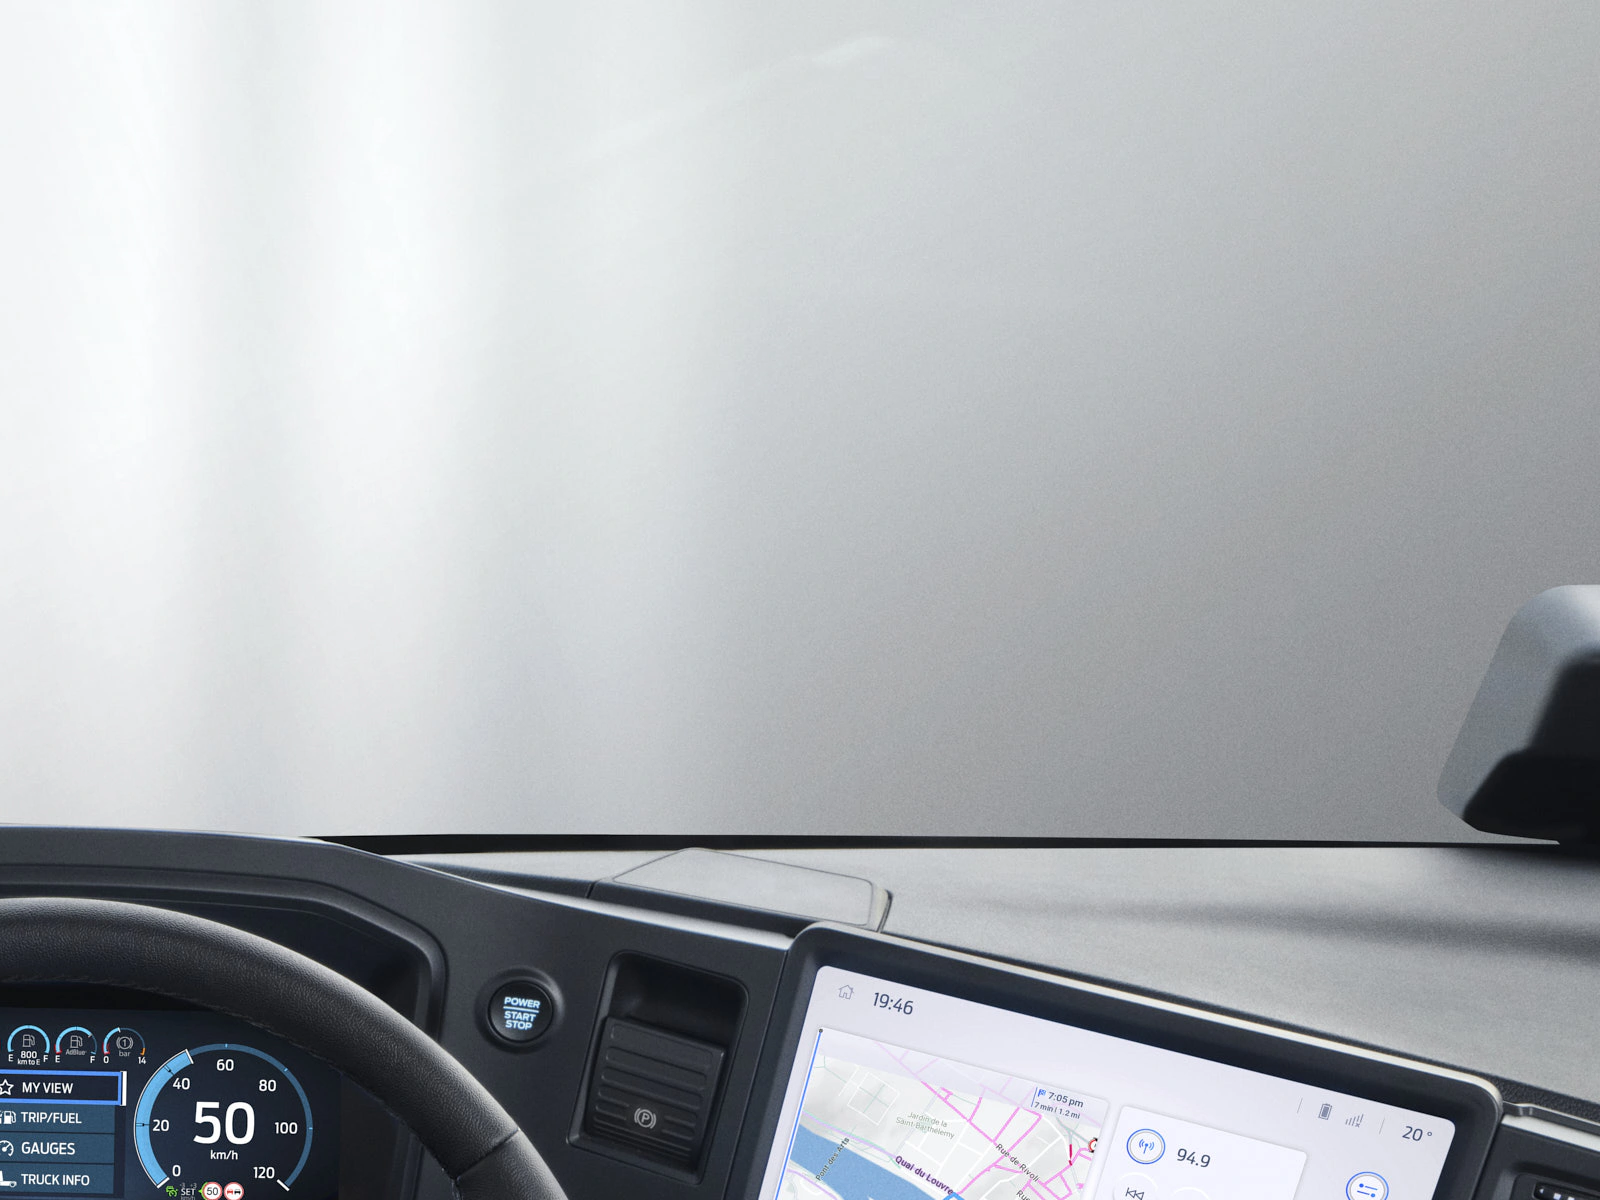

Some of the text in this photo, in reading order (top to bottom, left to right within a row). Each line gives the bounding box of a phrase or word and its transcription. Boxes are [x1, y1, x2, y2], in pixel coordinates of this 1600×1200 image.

[504, 996, 541, 1009] POWER
[873, 992, 913, 1015] 19:46
[504, 1011, 536, 1022] START
[505, 1020, 532, 1030] STOP
[8, 1054, 14, 1062] E
[20, 1050, 38, 1059] 800
[43, 1054, 49, 1063] F
[55, 1055, 61, 1063] E
[90, 1055, 96, 1064] F
[137, 1056, 146, 1065] 14
[216, 1059, 235, 1071] 60
[22, 1083, 74, 1094] MY VIEW
[172, 1078, 191, 1090] 40
[259, 1080, 277, 1092] 80
[1048, 1091, 1084, 1108] 7:05 pm
[21, 1112, 82, 1124] TRIP/FUEL
[193, 1101, 255, 1145] 50
[152, 1119, 170, 1132] 20
[274, 1122, 298, 1135] 100
[21, 1142, 76, 1155] GAUGES
[210, 1149, 238, 1161] km/h
[815, 1137, 850, 1181] Pont des Arts
[1176, 1148, 1211, 1169] 94.9
[996, 1143, 1040, 1182] Rue de Rivoli
[172, 1165, 181, 1177] 0
[253, 1167, 275, 1179] 120
[895, 1155, 954, 1195] Quai du Louvre
[21, 1173, 90, 1187] TRUCK INFO
[181, 1188, 196, 1196] SET
[206, 1187, 219, 1196] 50
